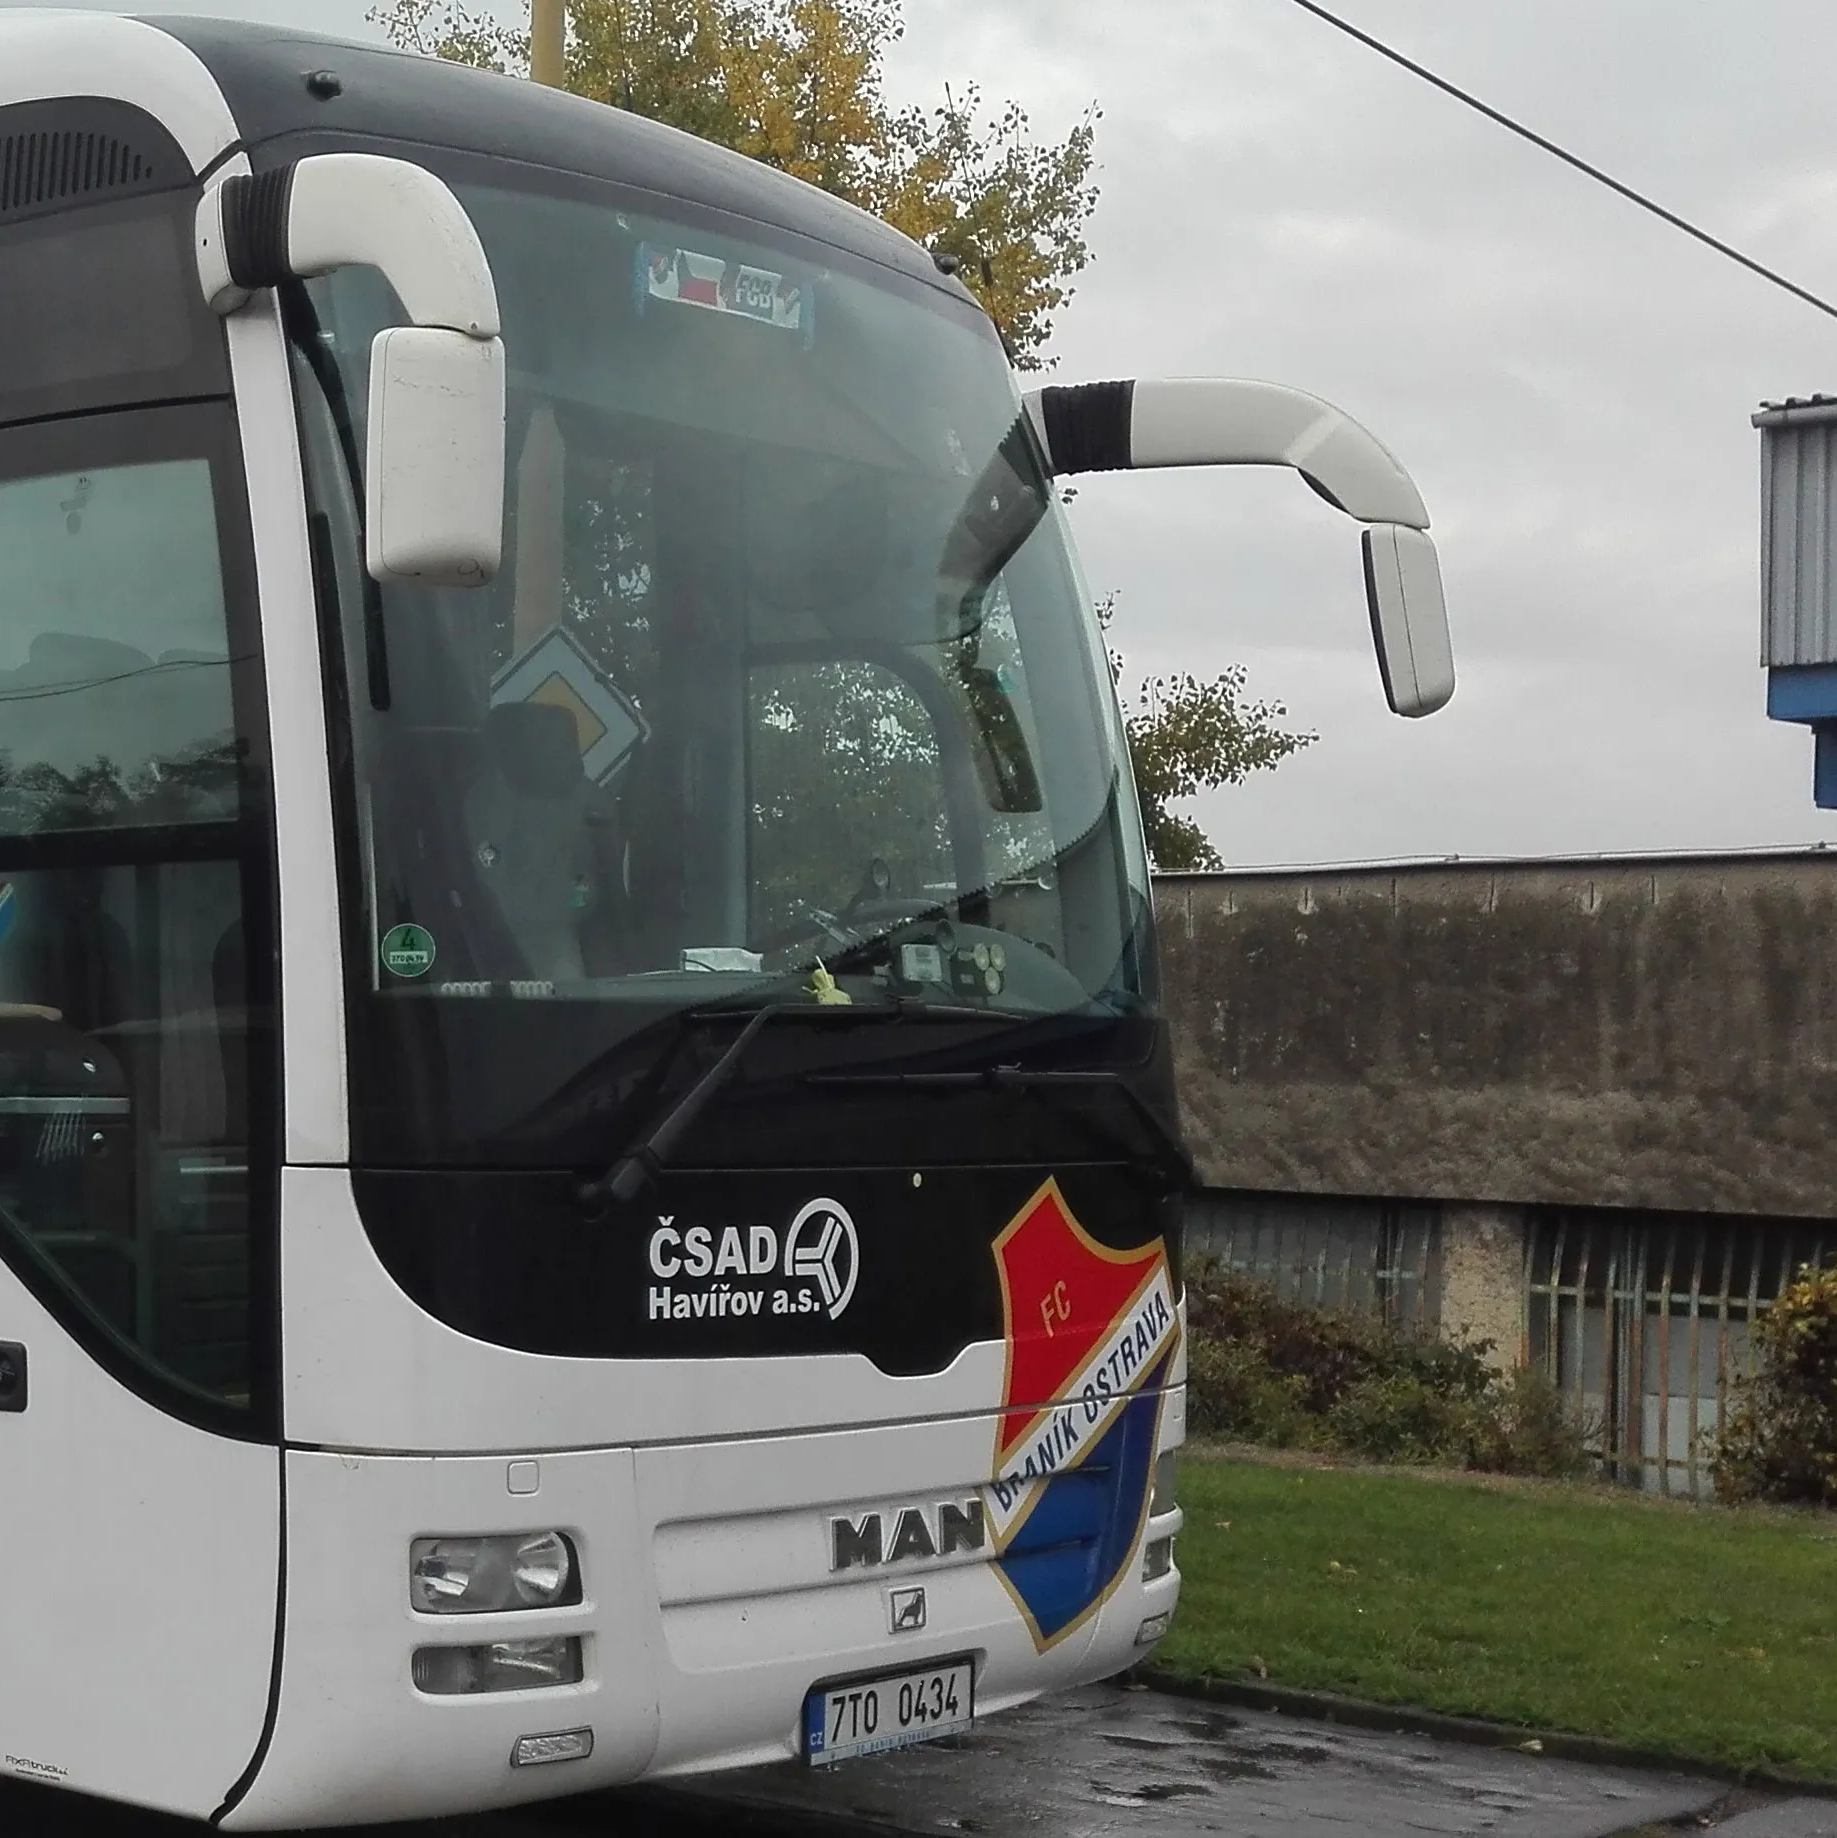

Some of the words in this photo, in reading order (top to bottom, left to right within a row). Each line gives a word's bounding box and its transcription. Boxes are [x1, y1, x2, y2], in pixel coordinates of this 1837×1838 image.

[649, 1215, 778, 1279] ČSAD
[649, 1283, 765, 1320] Havířov
[772, 1288, 821, 1315] a.s.
[1039, 1280, 1071, 1337] FC
[1082, 1291, 1170, 1424] OSTRAVA
[830, 1497, 985, 1572] MAN
[898, 1673, 959, 1727] 0434
[810, 1731, 824, 1746] CZ
